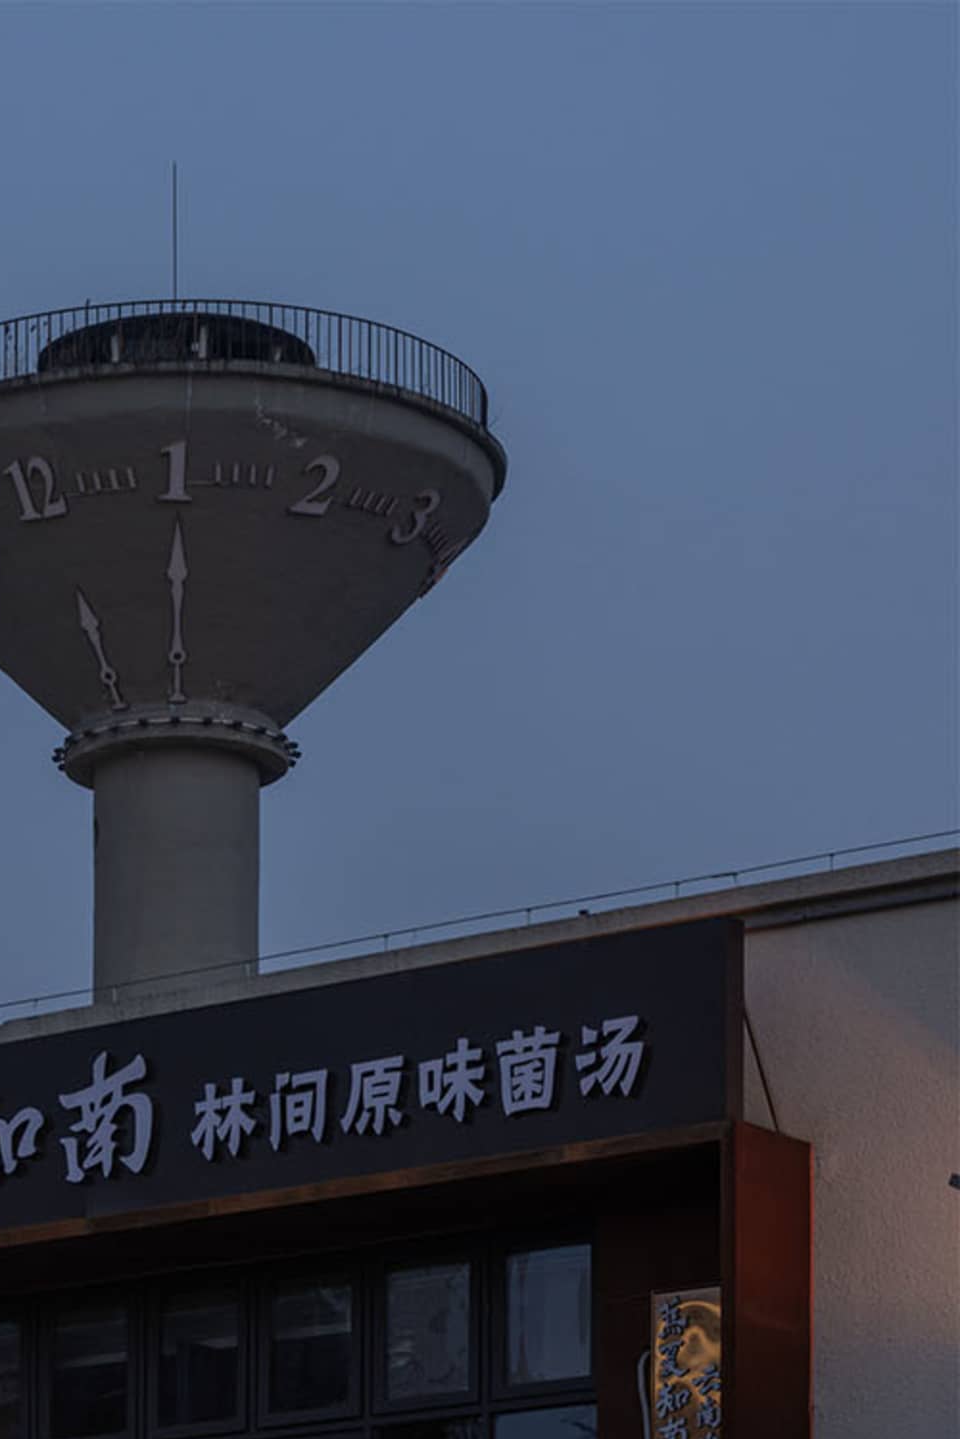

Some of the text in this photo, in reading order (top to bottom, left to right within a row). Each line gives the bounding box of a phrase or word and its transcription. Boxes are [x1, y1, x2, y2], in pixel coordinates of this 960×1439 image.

[2, 456, 69, 521] 12
[157, 439, 193, 502] 1
[288, 454, 341, 516] 2
[390, 489, 440, 543] 3
[190, 1014, 646, 1163] 林间原味菌汤
